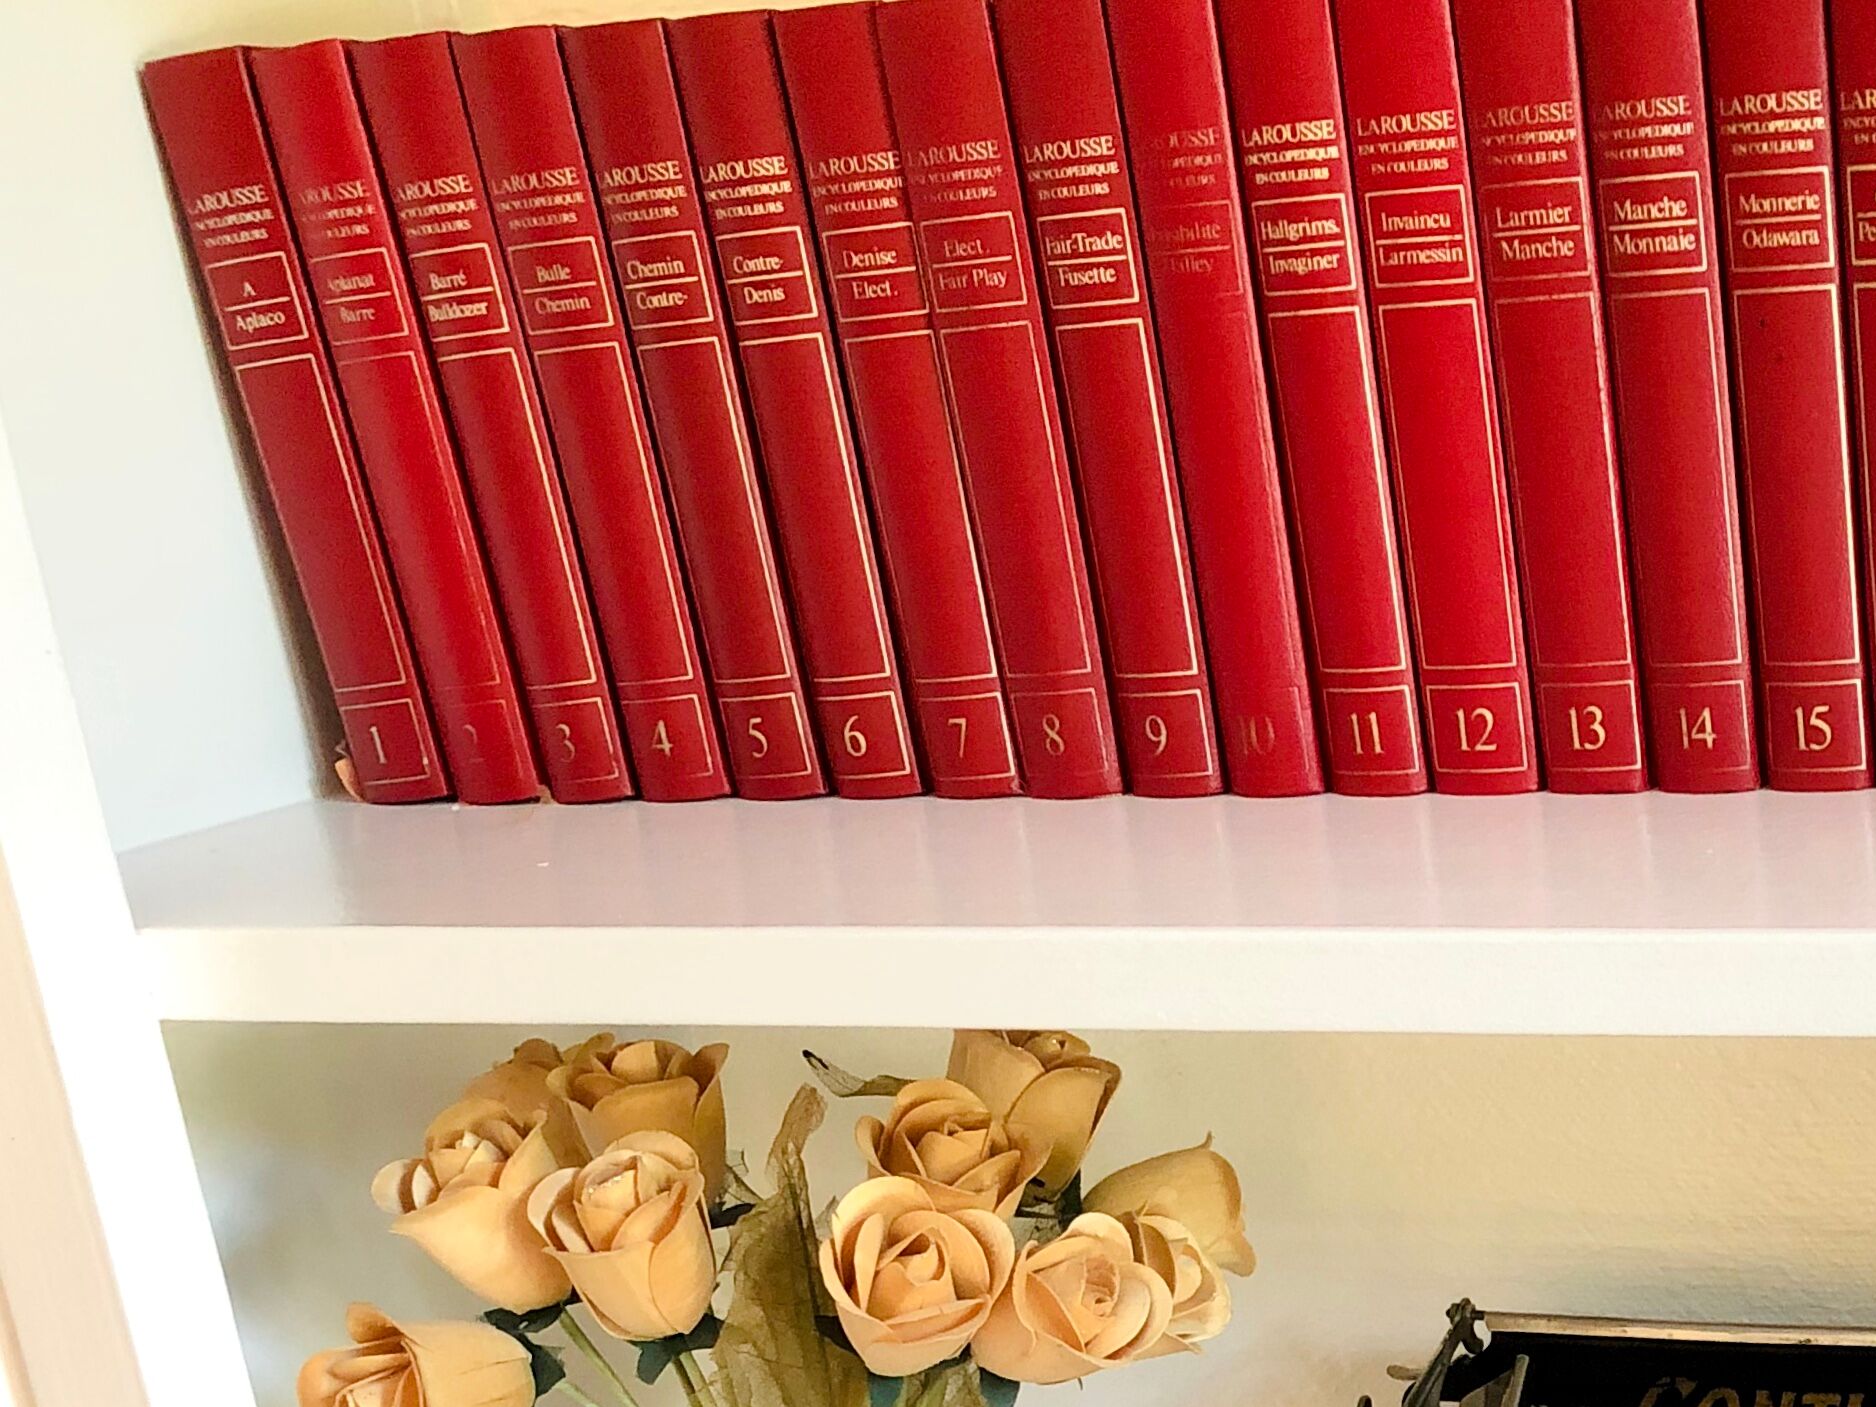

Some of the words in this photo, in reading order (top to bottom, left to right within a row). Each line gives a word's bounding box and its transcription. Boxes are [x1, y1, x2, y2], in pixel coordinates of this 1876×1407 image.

[1486, 101, 1575, 128] AROUSSE
[1720, 89, 1823, 117] LAROUSSE
[1242, 119, 1336, 147] LAROUSSE
[1357, 110, 1456, 137] LAROUSSE
[1024, 136, 1115, 163] LAROUSSE
[1854, 133, 1869, 145] EN
[809, 151, 901, 179] LAROUSSE
[1496, 202, 1573, 228] Larmier
[1613, 196, 1688, 223] Manche
[1739, 190, 1821, 215] Monnerie
[1261, 217, 1341, 241] Hallgrims.
[1381, 211, 1450, 232] Invaincu
[944, 239, 990, 258] Elect.
[1046, 230, 1123, 256] Fair-Trade
[1502, 236, 1574, 262] Manche
[1613, 228, 1697, 256] Monnaie
[1742, 228, 1820, 249] Odawara
[733, 256, 784, 274] Contre-
[843, 247, 897, 269] Denise
[1269, 252, 1340, 275] Invaginer
[1379, 242, 1463, 266] Larmessin
[430, 270, 468, 291] Barré
[536, 264, 571, 283] Bulle
[627, 257, 685, 280] Chemin
[972, 269, 1007, 288] Play
[1059, 266, 1117, 287] Fusette
[242, 282, 256, 297] A
[636, 291, 688, 310] Contre-
[744, 284, 786, 304] Denis
[852, 281, 898, 300] Elect.
[427, 301, 488, 322] Bulldozer
[535, 294, 591, 315] Chemin
[236, 310, 285, 333] Aplaco
[651, 719, 674, 758] 4
[747, 716, 770, 759] 5
[843, 714, 867, 758] 6
[947, 717, 967, 759] 7
[1041, 713, 1066, 757] 8
[1144, 714, 1168, 758] 9
[1350, 710, 1385, 756] 11
[1455, 706, 1499, 752] 12
[1567, 704, 1608, 752] 13
[1678, 705, 1717, 751] 14
[1794, 704, 1833, 752] 15
[369, 725, 389, 766] 1
[555, 722, 577, 762] 3
